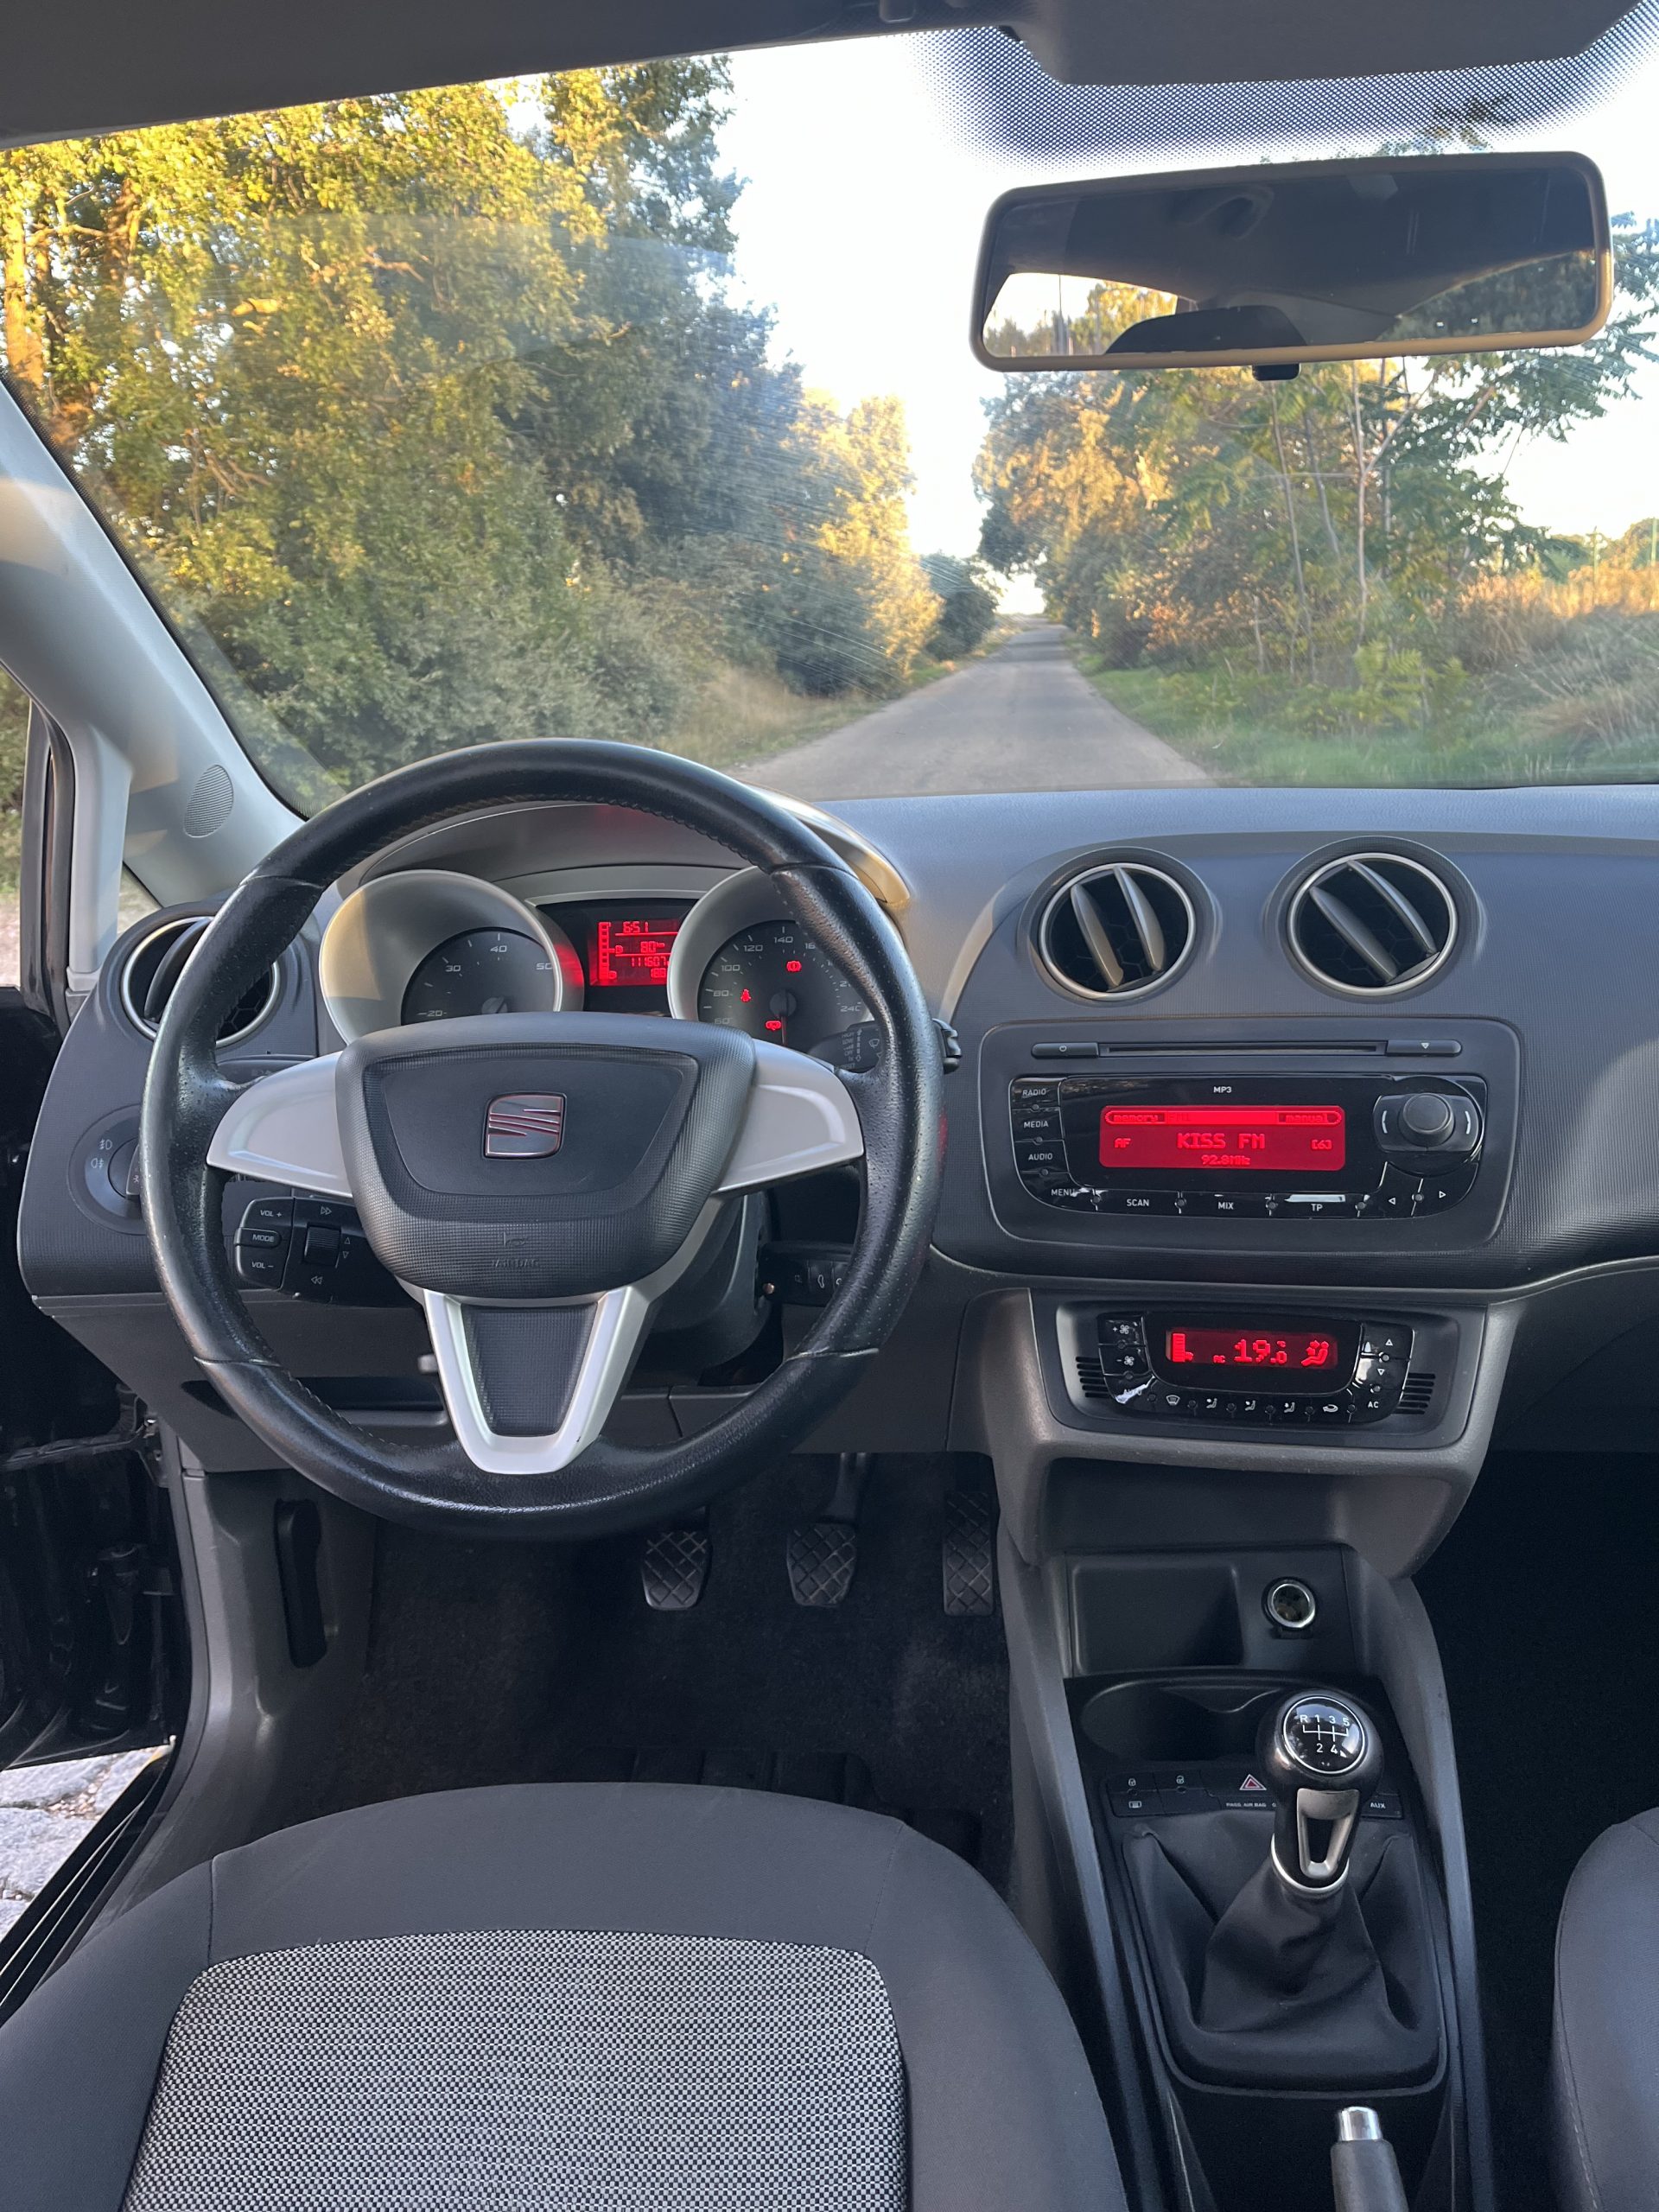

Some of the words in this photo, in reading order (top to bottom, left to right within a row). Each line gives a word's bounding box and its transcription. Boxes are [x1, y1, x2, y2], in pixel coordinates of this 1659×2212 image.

[623, 921, 648, 932] 6:51
[1021, 1088, 1047, 1096] RADIO
[1213, 1085, 1232, 1094] MP3
[1023, 1120, 1049, 1128] MEDIA
[1114, 1137, 1132, 1149] AF
[1176, 1133, 1227, 1150] KISS
[1238, 1133, 1267, 1150] FM
[1027, 1153, 1054, 1161] AUDIO
[1200, 1154, 1251, 1166] 92.8MHz
[1051, 1188, 1076, 1197] MENU
[1126, 1198, 1150, 1207] SCAN
[1217, 1202, 1234, 1211] MIX
[252, 1234, 275, 1243] MODE
[1300, 1714, 1308, 1723] R
[1314, 1714, 1320, 1723] 1
[1328, 1715, 1336, 1724] 3
[1342, 1717, 1351, 1726] 5
[1316, 1743, 1323, 1753] 2
[1330, 1744, 1338, 1754] 4
